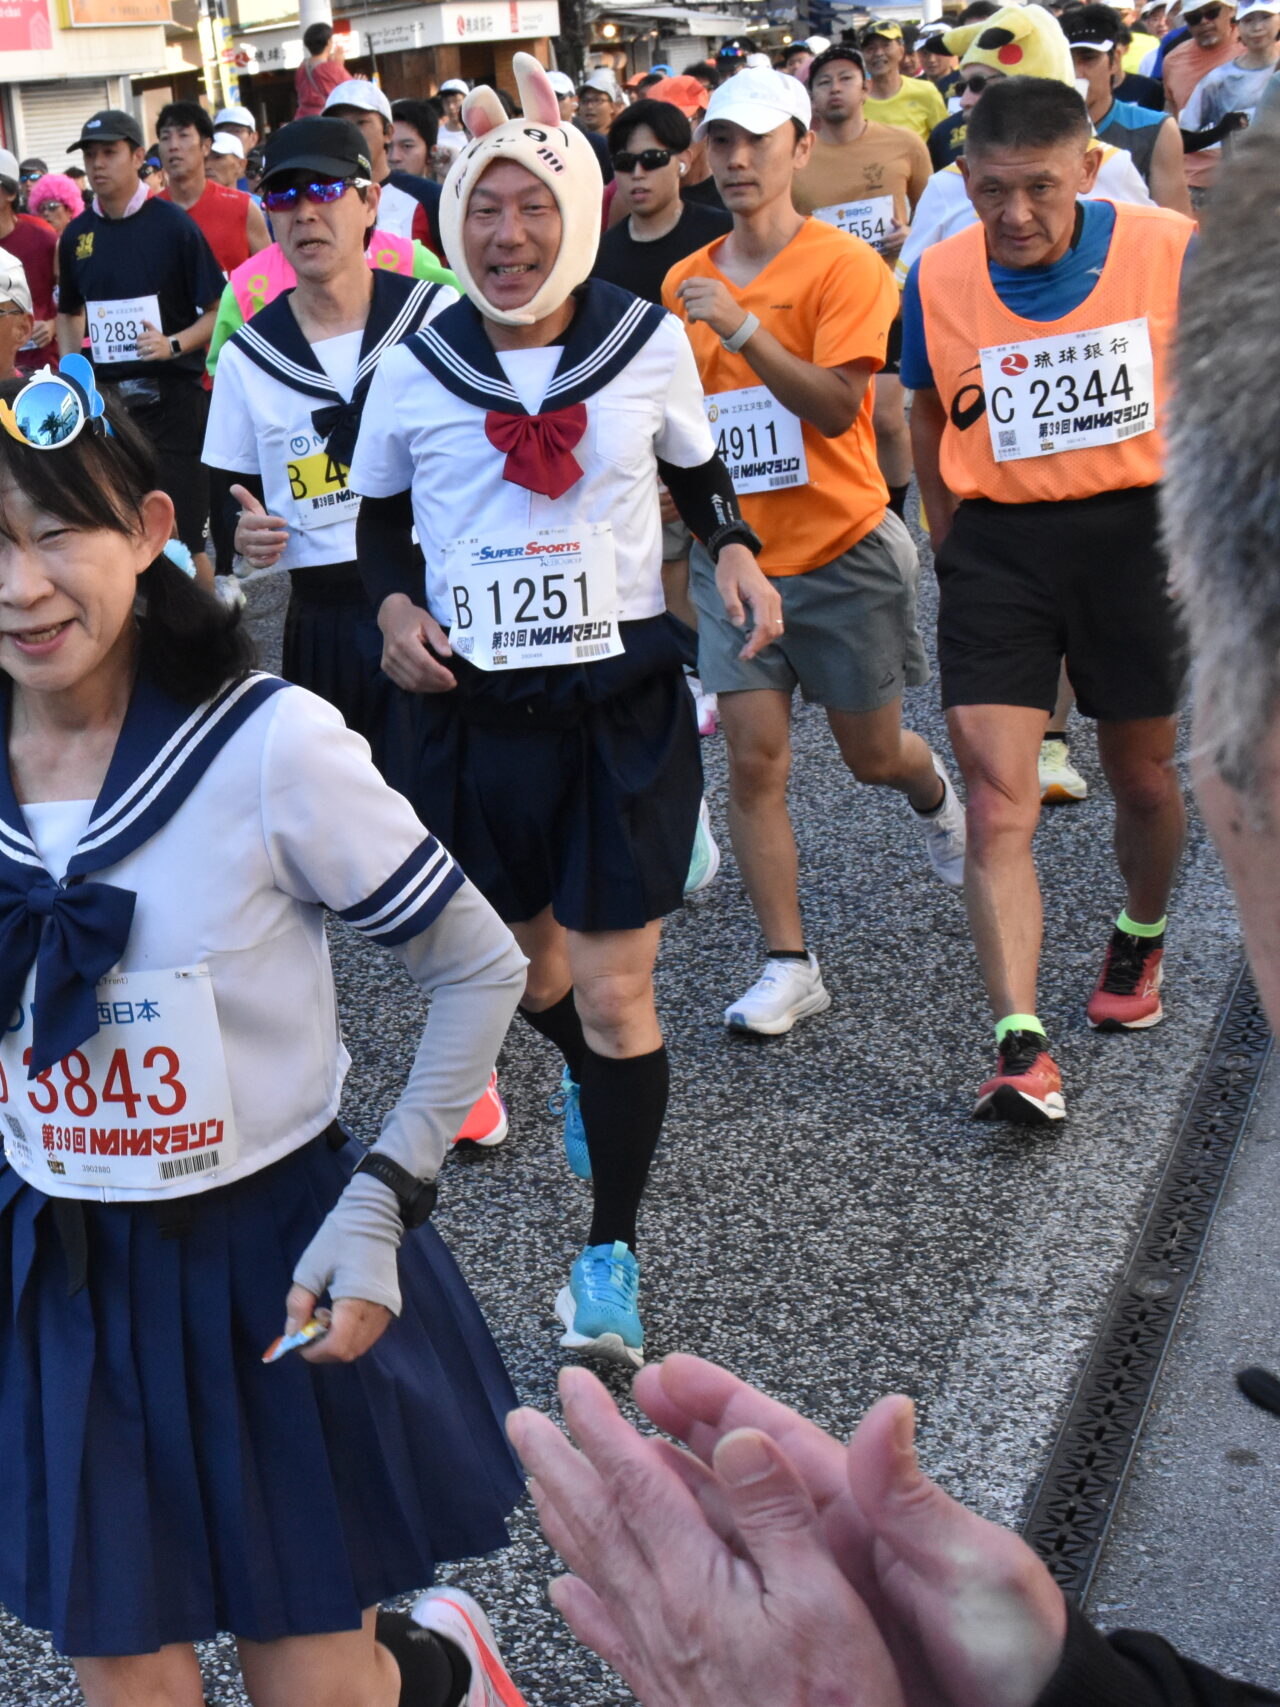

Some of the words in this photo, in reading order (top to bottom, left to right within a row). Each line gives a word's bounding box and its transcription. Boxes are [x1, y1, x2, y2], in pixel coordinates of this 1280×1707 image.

[91, 323, 100, 344] D
[1034, 337, 1129, 369] 琉球銀行
[991, 386, 1015, 424] C
[1029, 363, 1134, 419] 2344
[1038, 419, 1070, 439] 第39回
[1072, 402, 1150, 433] NAHAマラソン
[717, 420, 778, 463] 4911
[287, 464, 308, 500] B
[740, 456, 800, 479] NAHAマラソン
[453, 585, 473, 630] B
[486, 571, 589, 625] 1251
[491, 629, 527, 650] 第39回
[529, 620, 612, 647] NAHAマラソン
[22, 1045, 187, 1119] 3843
[41, 1122, 87, 1155] 第39回
[89, 1118, 224, 1157] NAHAマラソン
